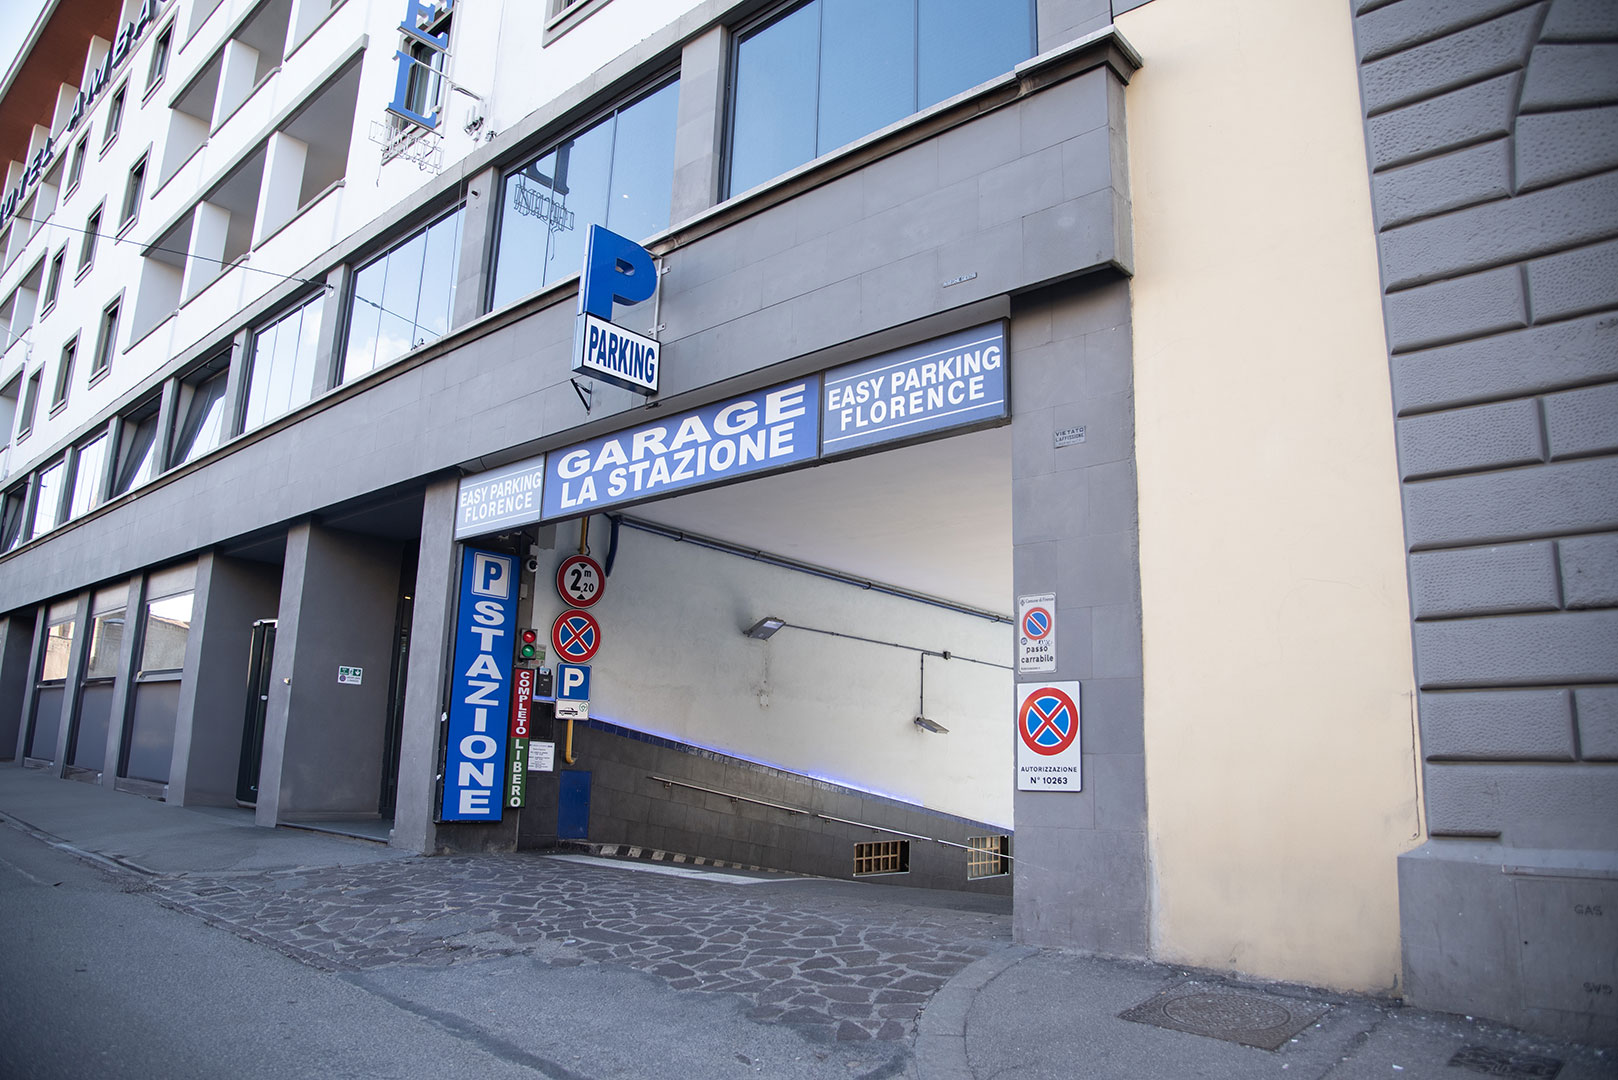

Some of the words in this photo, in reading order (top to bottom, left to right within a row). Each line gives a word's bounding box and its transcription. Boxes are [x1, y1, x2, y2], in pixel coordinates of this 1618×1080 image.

[585, 224, 657, 320] P
[588, 324, 656, 384] PARKING
[828, 376, 886, 412] EASY
[890, 345, 1001, 396] PARKING
[840, 374, 985, 432] FLORENCE
[556, 383, 806, 480] GARAGE
[460, 485, 489, 507] EASY
[489, 470, 542, 499] PARKING
[560, 479, 598, 509] LA
[606, 421, 796, 498] STAZIONE
[464, 491, 533, 523] FLORENCE
[482, 561, 503, 591] P
[1020, 654, 1054, 664] carrabile
[1026, 645, 1049, 654] passo
[515, 671, 531, 735] COMPLETO
[563, 667, 585, 697] P
[458, 600, 505, 815] STAZIONE
[510, 739, 524, 808] LIBERO
[1021, 765, 1077, 773] AUTORIZZAZIONE
[1042, 777, 1068, 785] 10263
[1574, 904, 1603, 916] GAS
